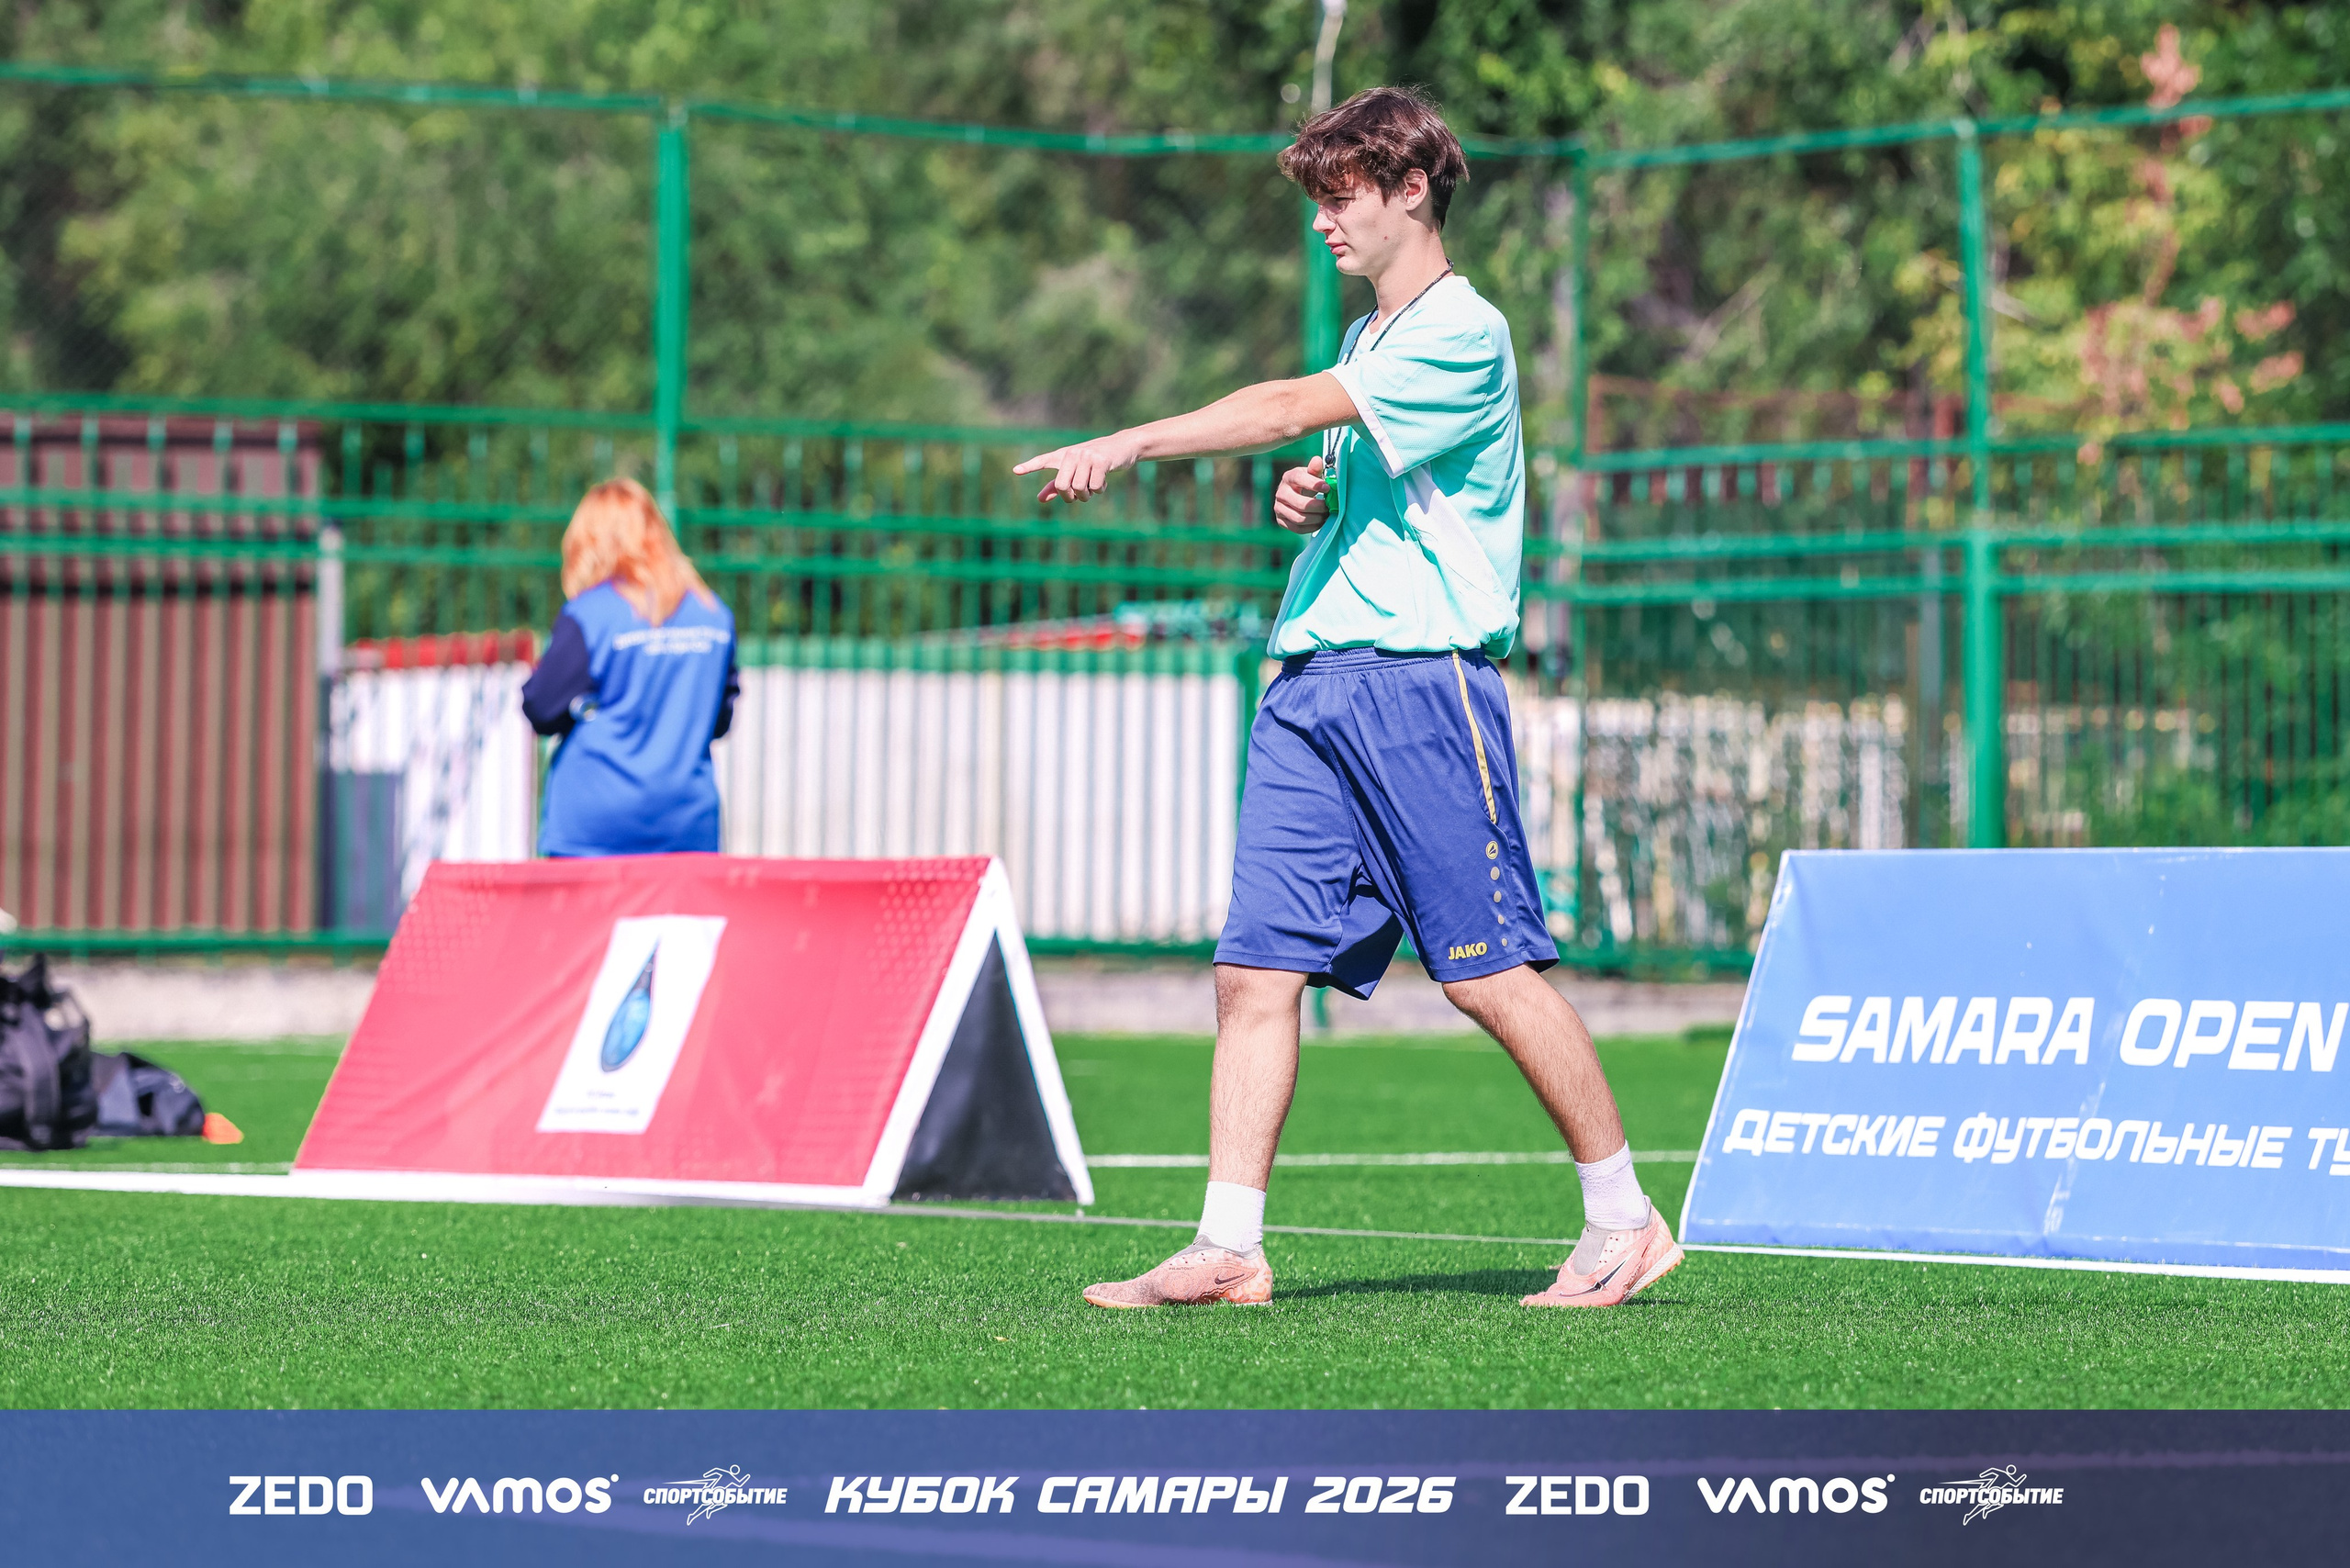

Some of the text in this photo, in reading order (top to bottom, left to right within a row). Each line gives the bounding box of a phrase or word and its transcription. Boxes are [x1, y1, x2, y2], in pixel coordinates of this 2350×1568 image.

[1448, 941, 1488, 960] JAKO
[1791, 995, 2350, 1072] SAMARA OPEN
[1722, 1108, 1946, 1158] ДЕТСКИЕ
[1953, 1112, 2293, 1170] ФУТБОЛЬНЫЕ
